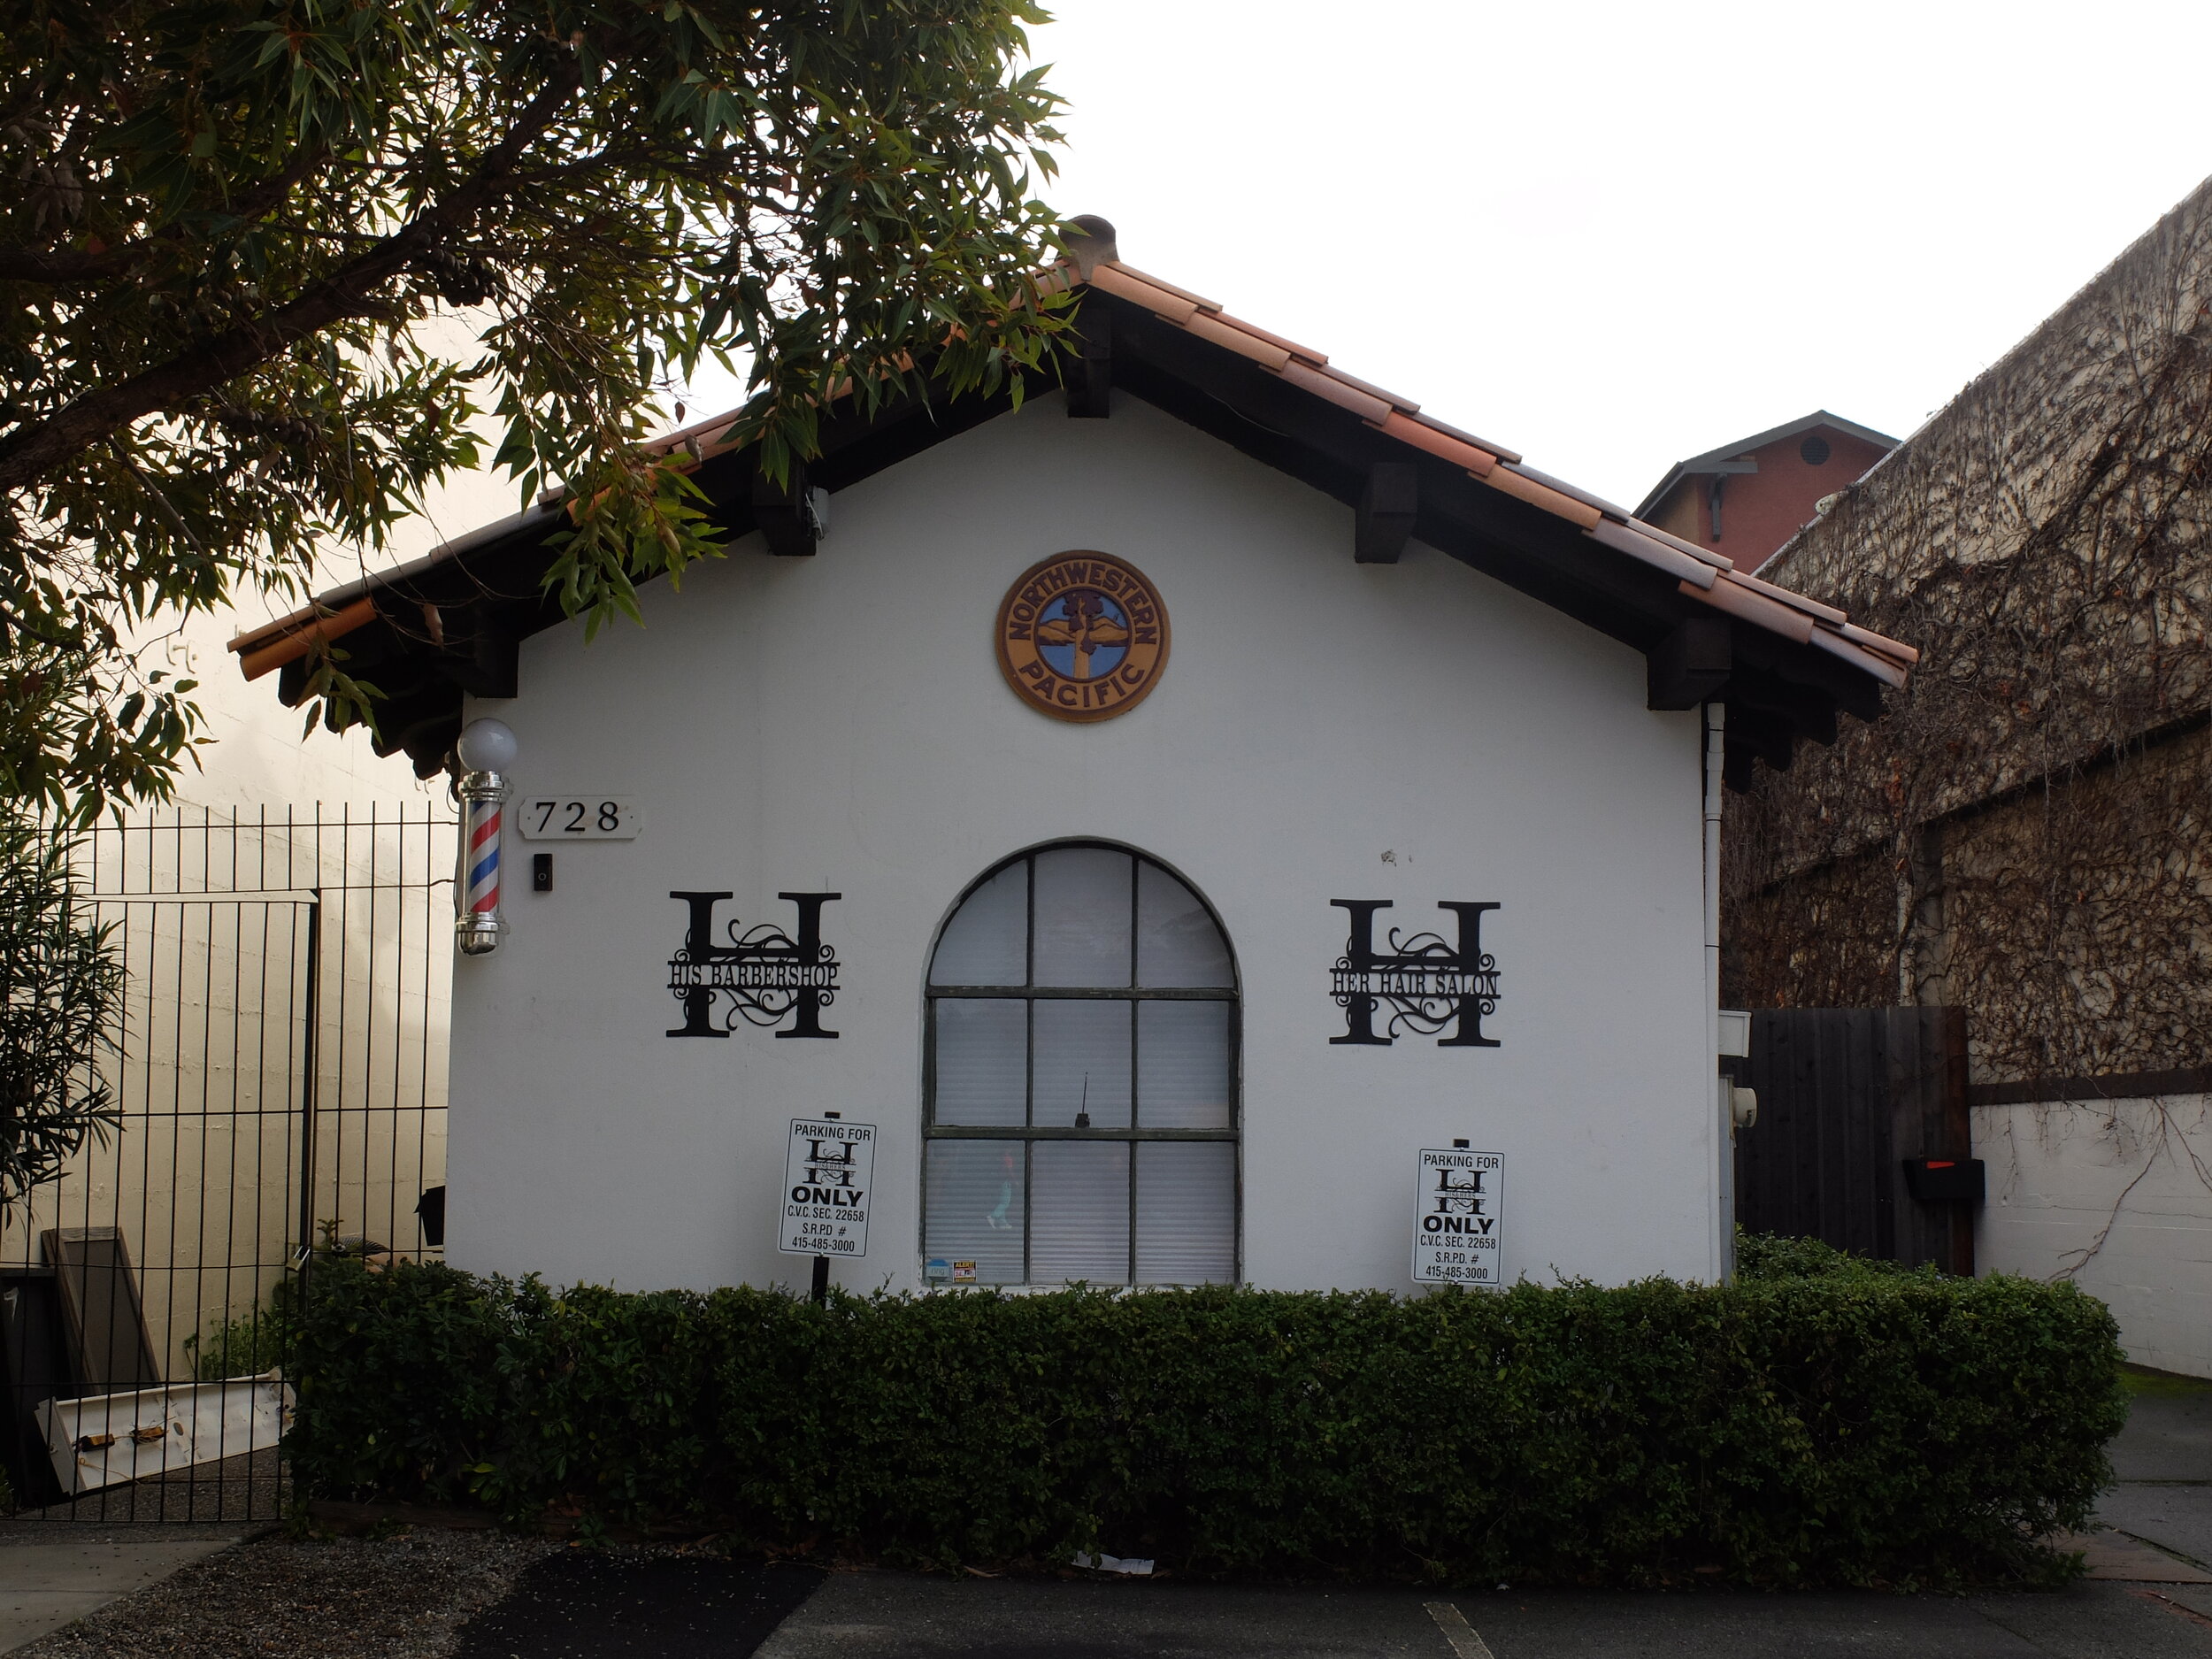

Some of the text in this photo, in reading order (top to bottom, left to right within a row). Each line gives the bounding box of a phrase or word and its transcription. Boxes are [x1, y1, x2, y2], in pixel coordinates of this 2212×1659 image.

[1010, 562, 1157, 645] NORTHWESTERN
[1018, 659, 1145, 708] PACIFIC
[536, 802, 618, 832] 728
[671, 964, 838, 988] HIS BARBERSHOP
[1333, 972, 1498, 996] HER HAIR SALON
[795, 1124, 871, 1141] PARKING FOR
[1424, 1154, 1499, 1169] PARKING FOR
[791, 1186, 864, 1207] ONLY
[787, 1205, 864, 1222] C.V.C. SEC. 22658
[838, 1226, 847, 1236] #
[1423, 1216, 1494, 1235] ONLY
[792, 1236, 855, 1252] 415-485-3000
[1420, 1235, 1496, 1249] C.V.C. SEC. 22658
[1435, 1251, 1479, 1264] S.R.P.D. #
[1425, 1265, 1488, 1279] 415-485-3000
